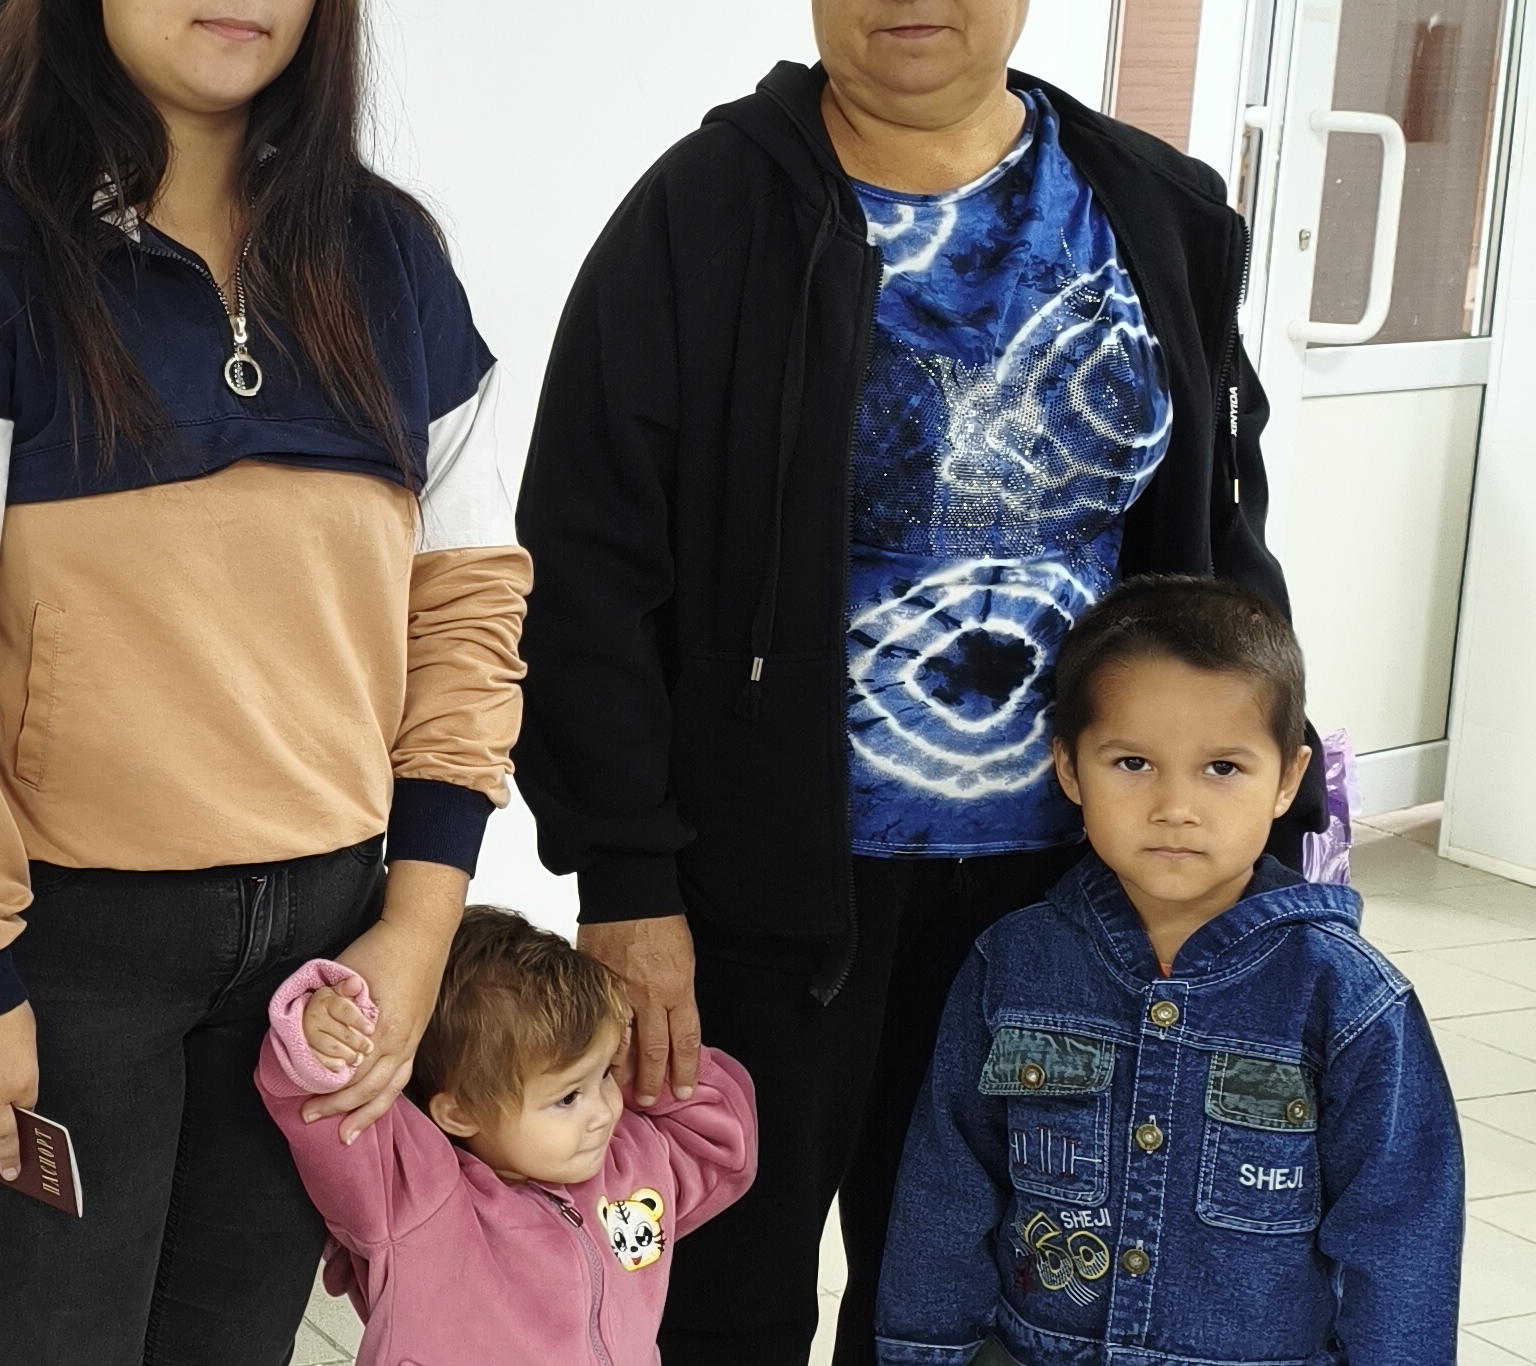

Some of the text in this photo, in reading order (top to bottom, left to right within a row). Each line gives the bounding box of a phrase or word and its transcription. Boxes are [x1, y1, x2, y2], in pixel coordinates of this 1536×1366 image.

[34, 1127, 62, 1197] ПАСПОРТ
[1239, 1163, 1304, 1191] SHEJI
[1060, 1207, 1112, 1230] SHEJI
